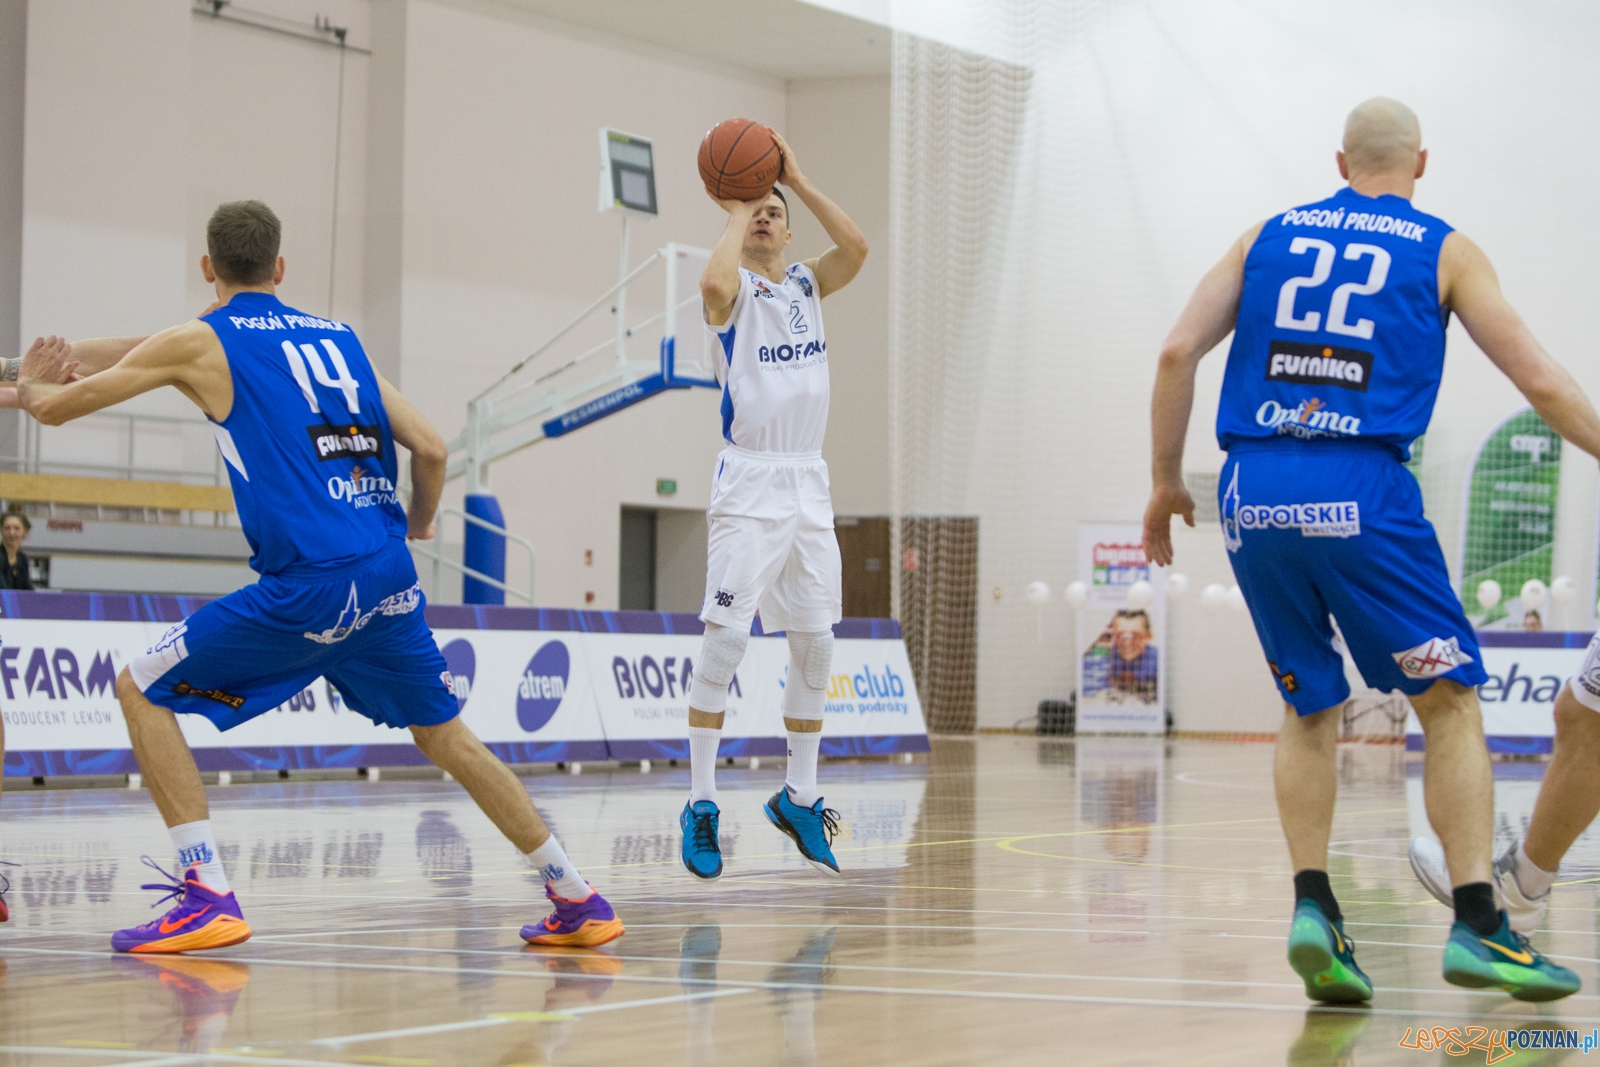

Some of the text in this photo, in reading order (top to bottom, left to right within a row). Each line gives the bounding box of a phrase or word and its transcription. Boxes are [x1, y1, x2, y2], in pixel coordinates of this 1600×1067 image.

[1282, 207, 1428, 243] POGOŃ PRUDNIK
[1275, 236, 1392, 340] 22
[228, 311, 288, 331] POGOŃ
[789, 300, 808, 334] 2
[281, 338, 360, 414] 14
[1269, 347, 1364, 383] furnika
[1241, 504, 1357, 526] OPOLSKIE
[0, 647, 118, 700] FARM
[520, 669, 564, 699] atrem
[825, 664, 905, 698] unclub
[1477, 662, 1562, 703] eha
[73, 707, 112, 726] LEKÓW
